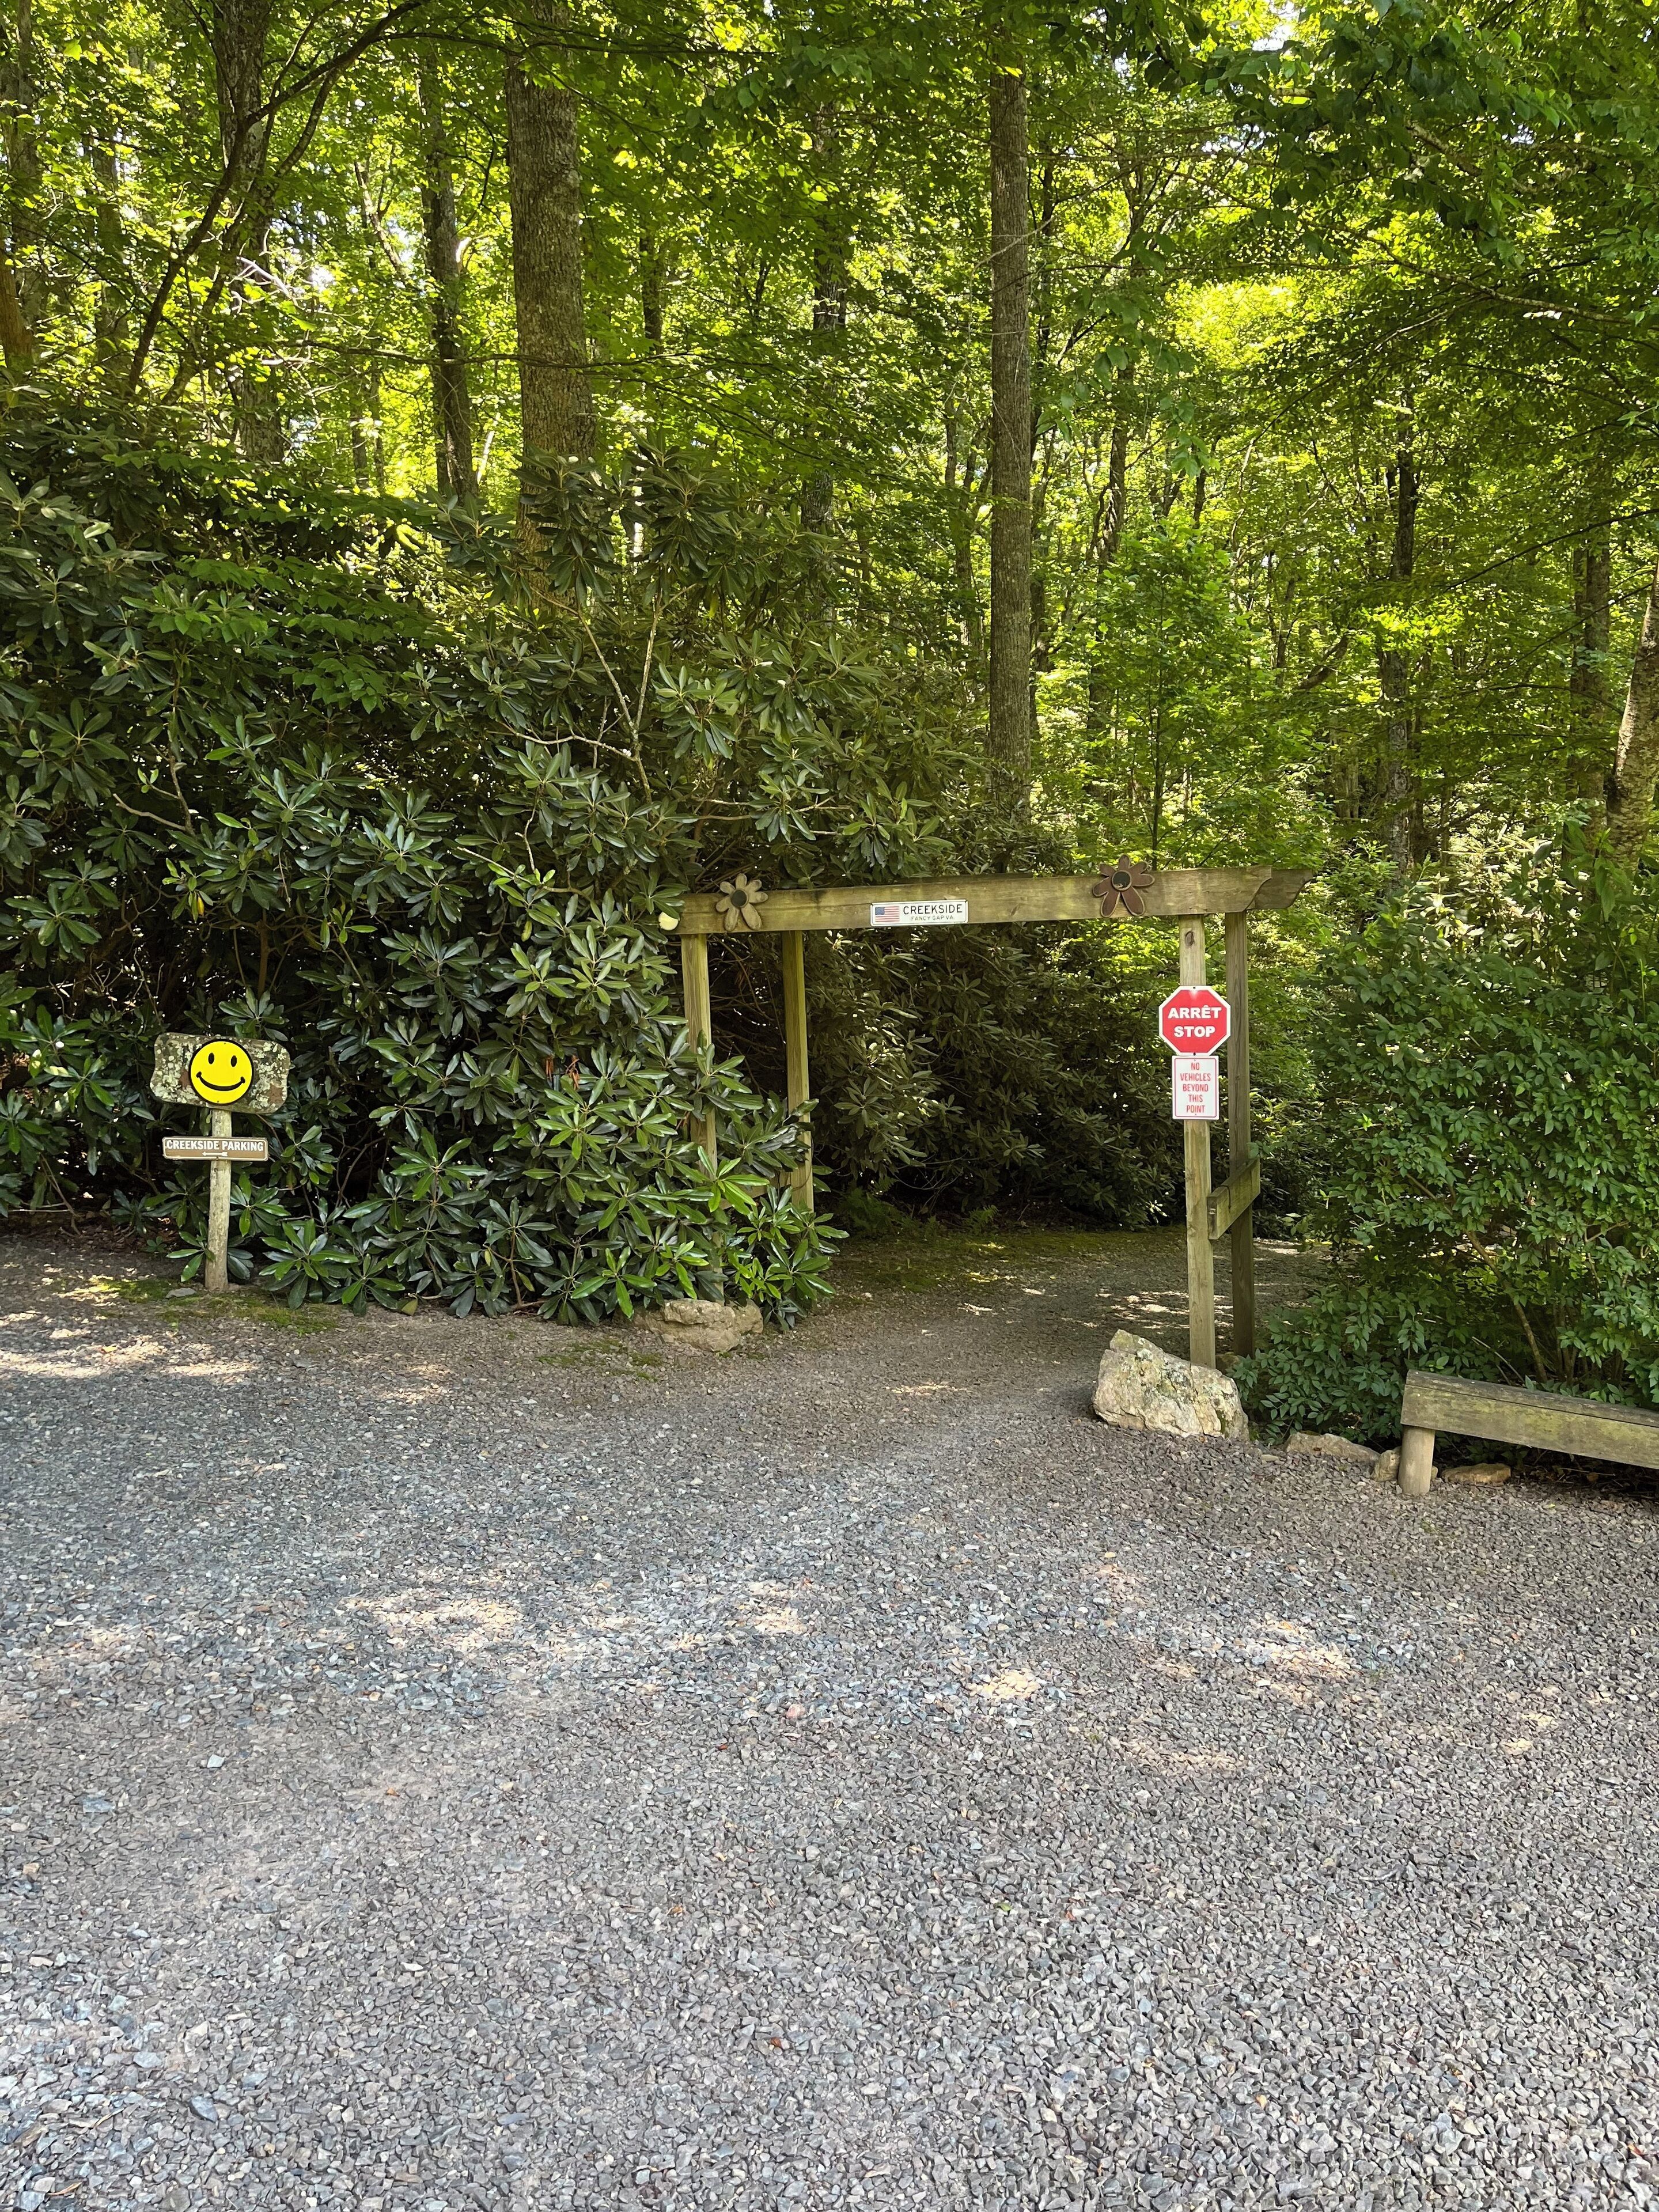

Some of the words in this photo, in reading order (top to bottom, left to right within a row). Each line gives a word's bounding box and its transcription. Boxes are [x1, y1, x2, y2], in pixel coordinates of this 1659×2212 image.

[903, 904, 963, 915] CREEKSIDE
[1168, 1005, 1222, 1019] ARRÊT
[1173, 1026, 1215, 1037] STOP
[1191, 1062, 1200, 1070] NO
[1180, 1073, 1211, 1081] VEHICLES
[1183, 1084, 1209, 1092] BEYOND
[1188, 1094, 1203, 1103] THIS
[1186, 1105, 1205, 1113] POINT
[166, 1139, 219, 1150] CREEKSIDE
[222, 1141, 264, 1152] PARKING
